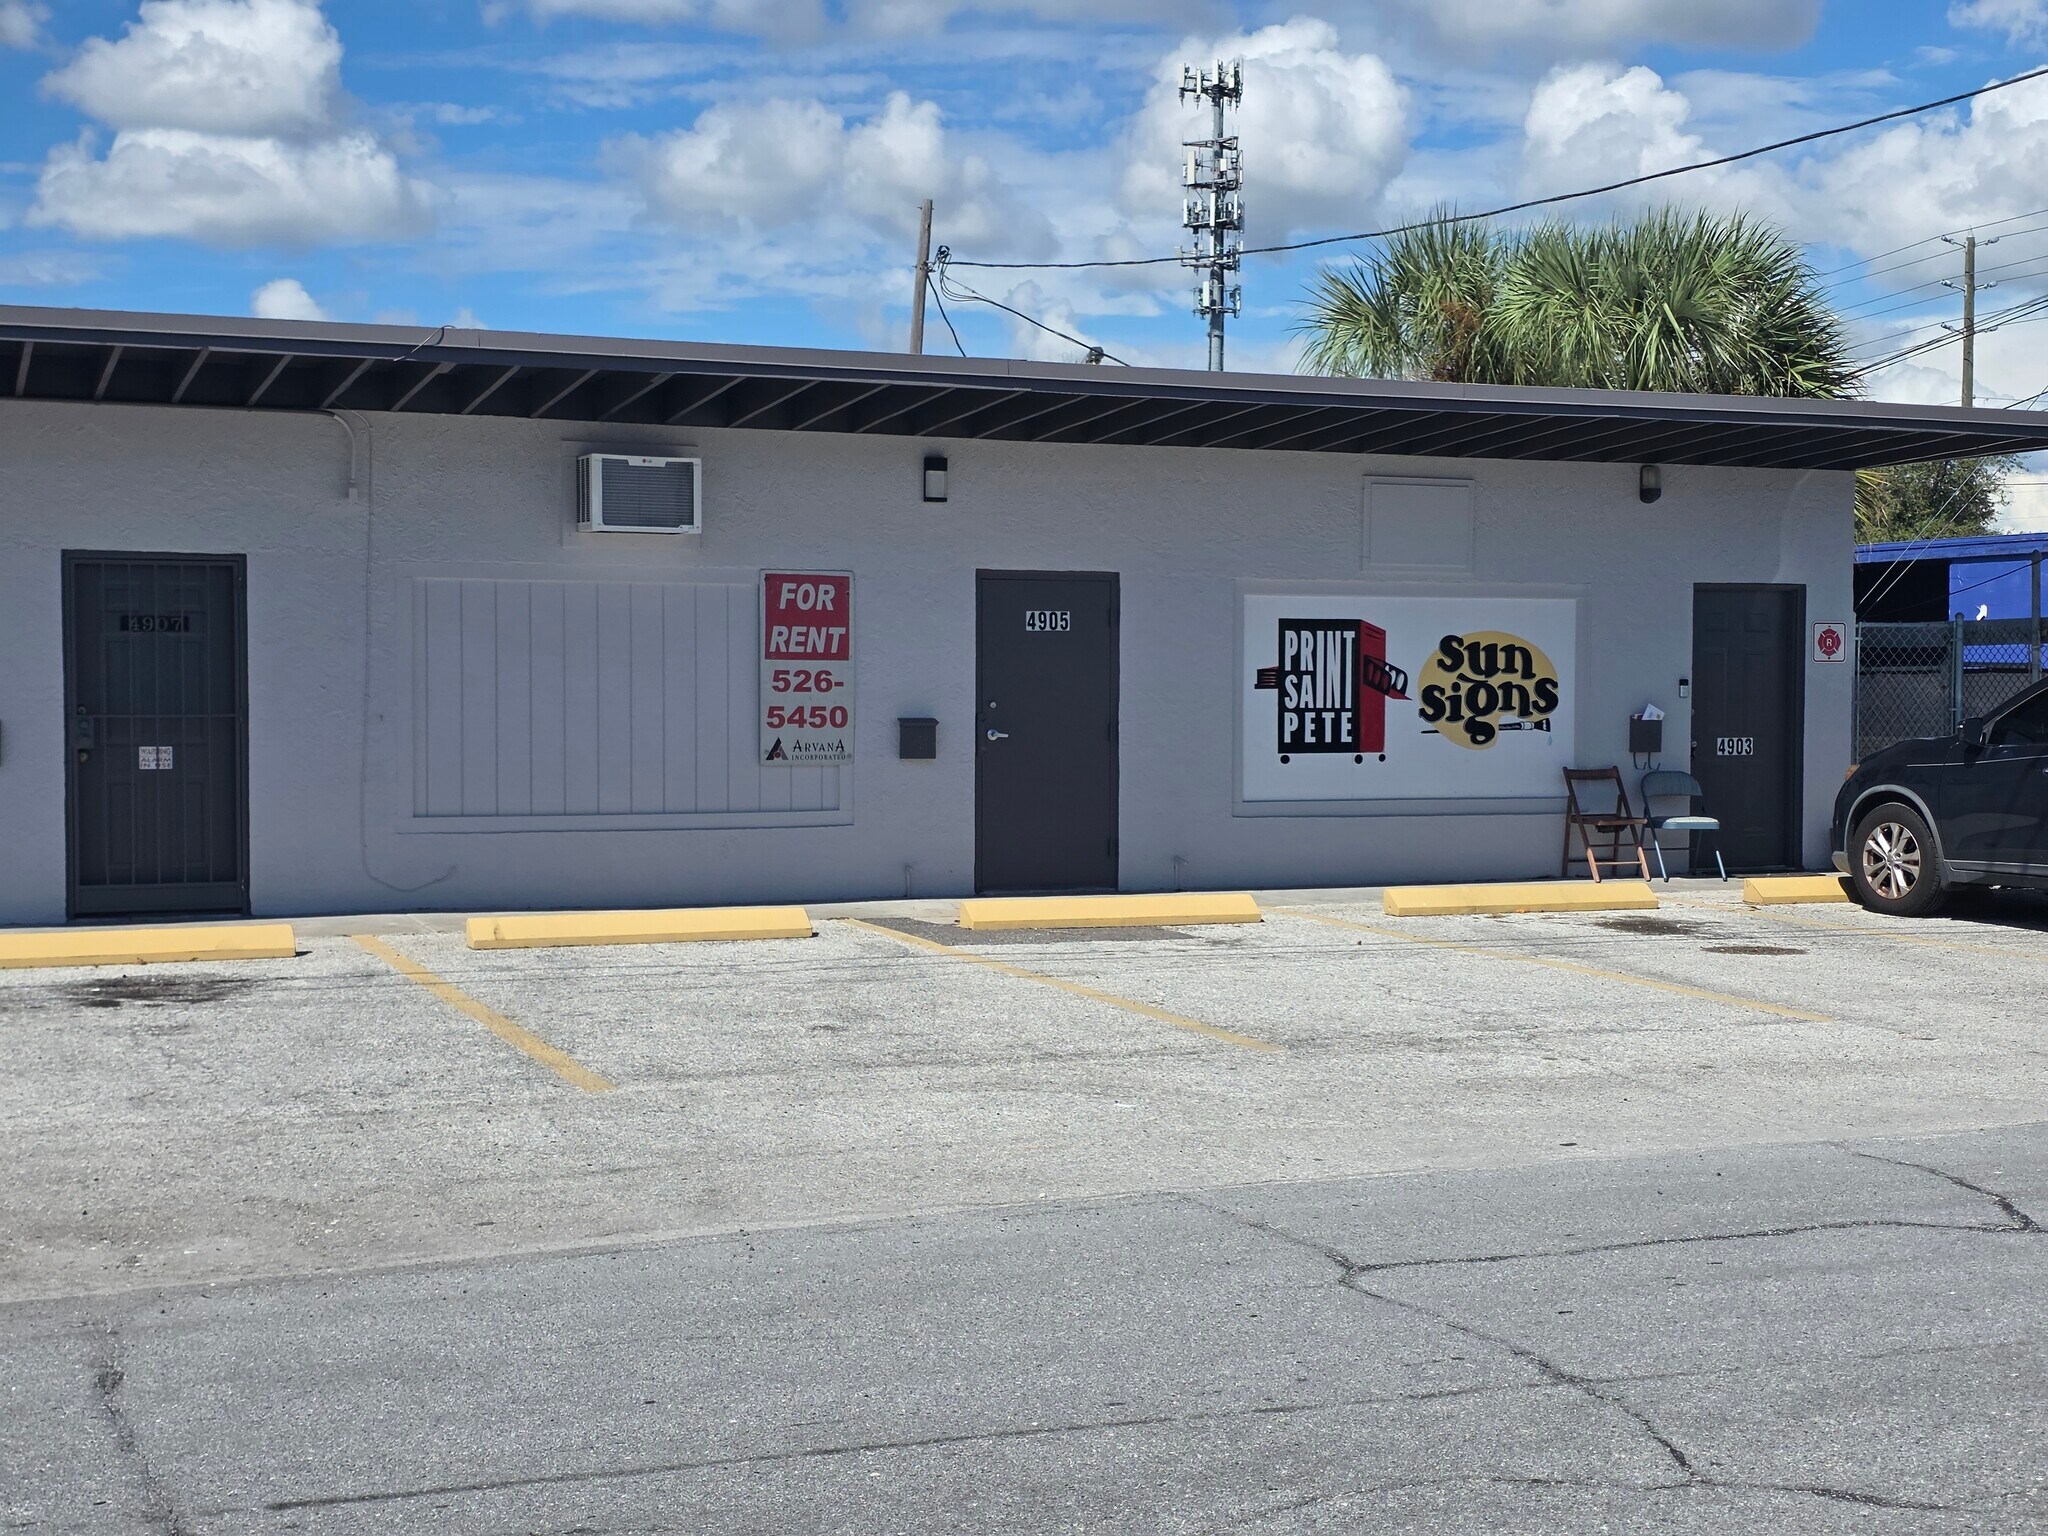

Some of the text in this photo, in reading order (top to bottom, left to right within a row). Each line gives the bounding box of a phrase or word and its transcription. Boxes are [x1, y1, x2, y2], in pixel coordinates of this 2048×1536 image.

[779, 582, 836, 611] FOR
[128, 616, 183, 632] 4907
[1027, 611, 1069, 630] 4905
[769, 625, 846, 654] RENT
[1826, 638, 1833, 647] R
[772, 669, 845, 693] 526-
[766, 705, 849, 729] 5450
[1284, 711, 1352, 743] PETE
[1718, 738, 1752, 755] 4903
